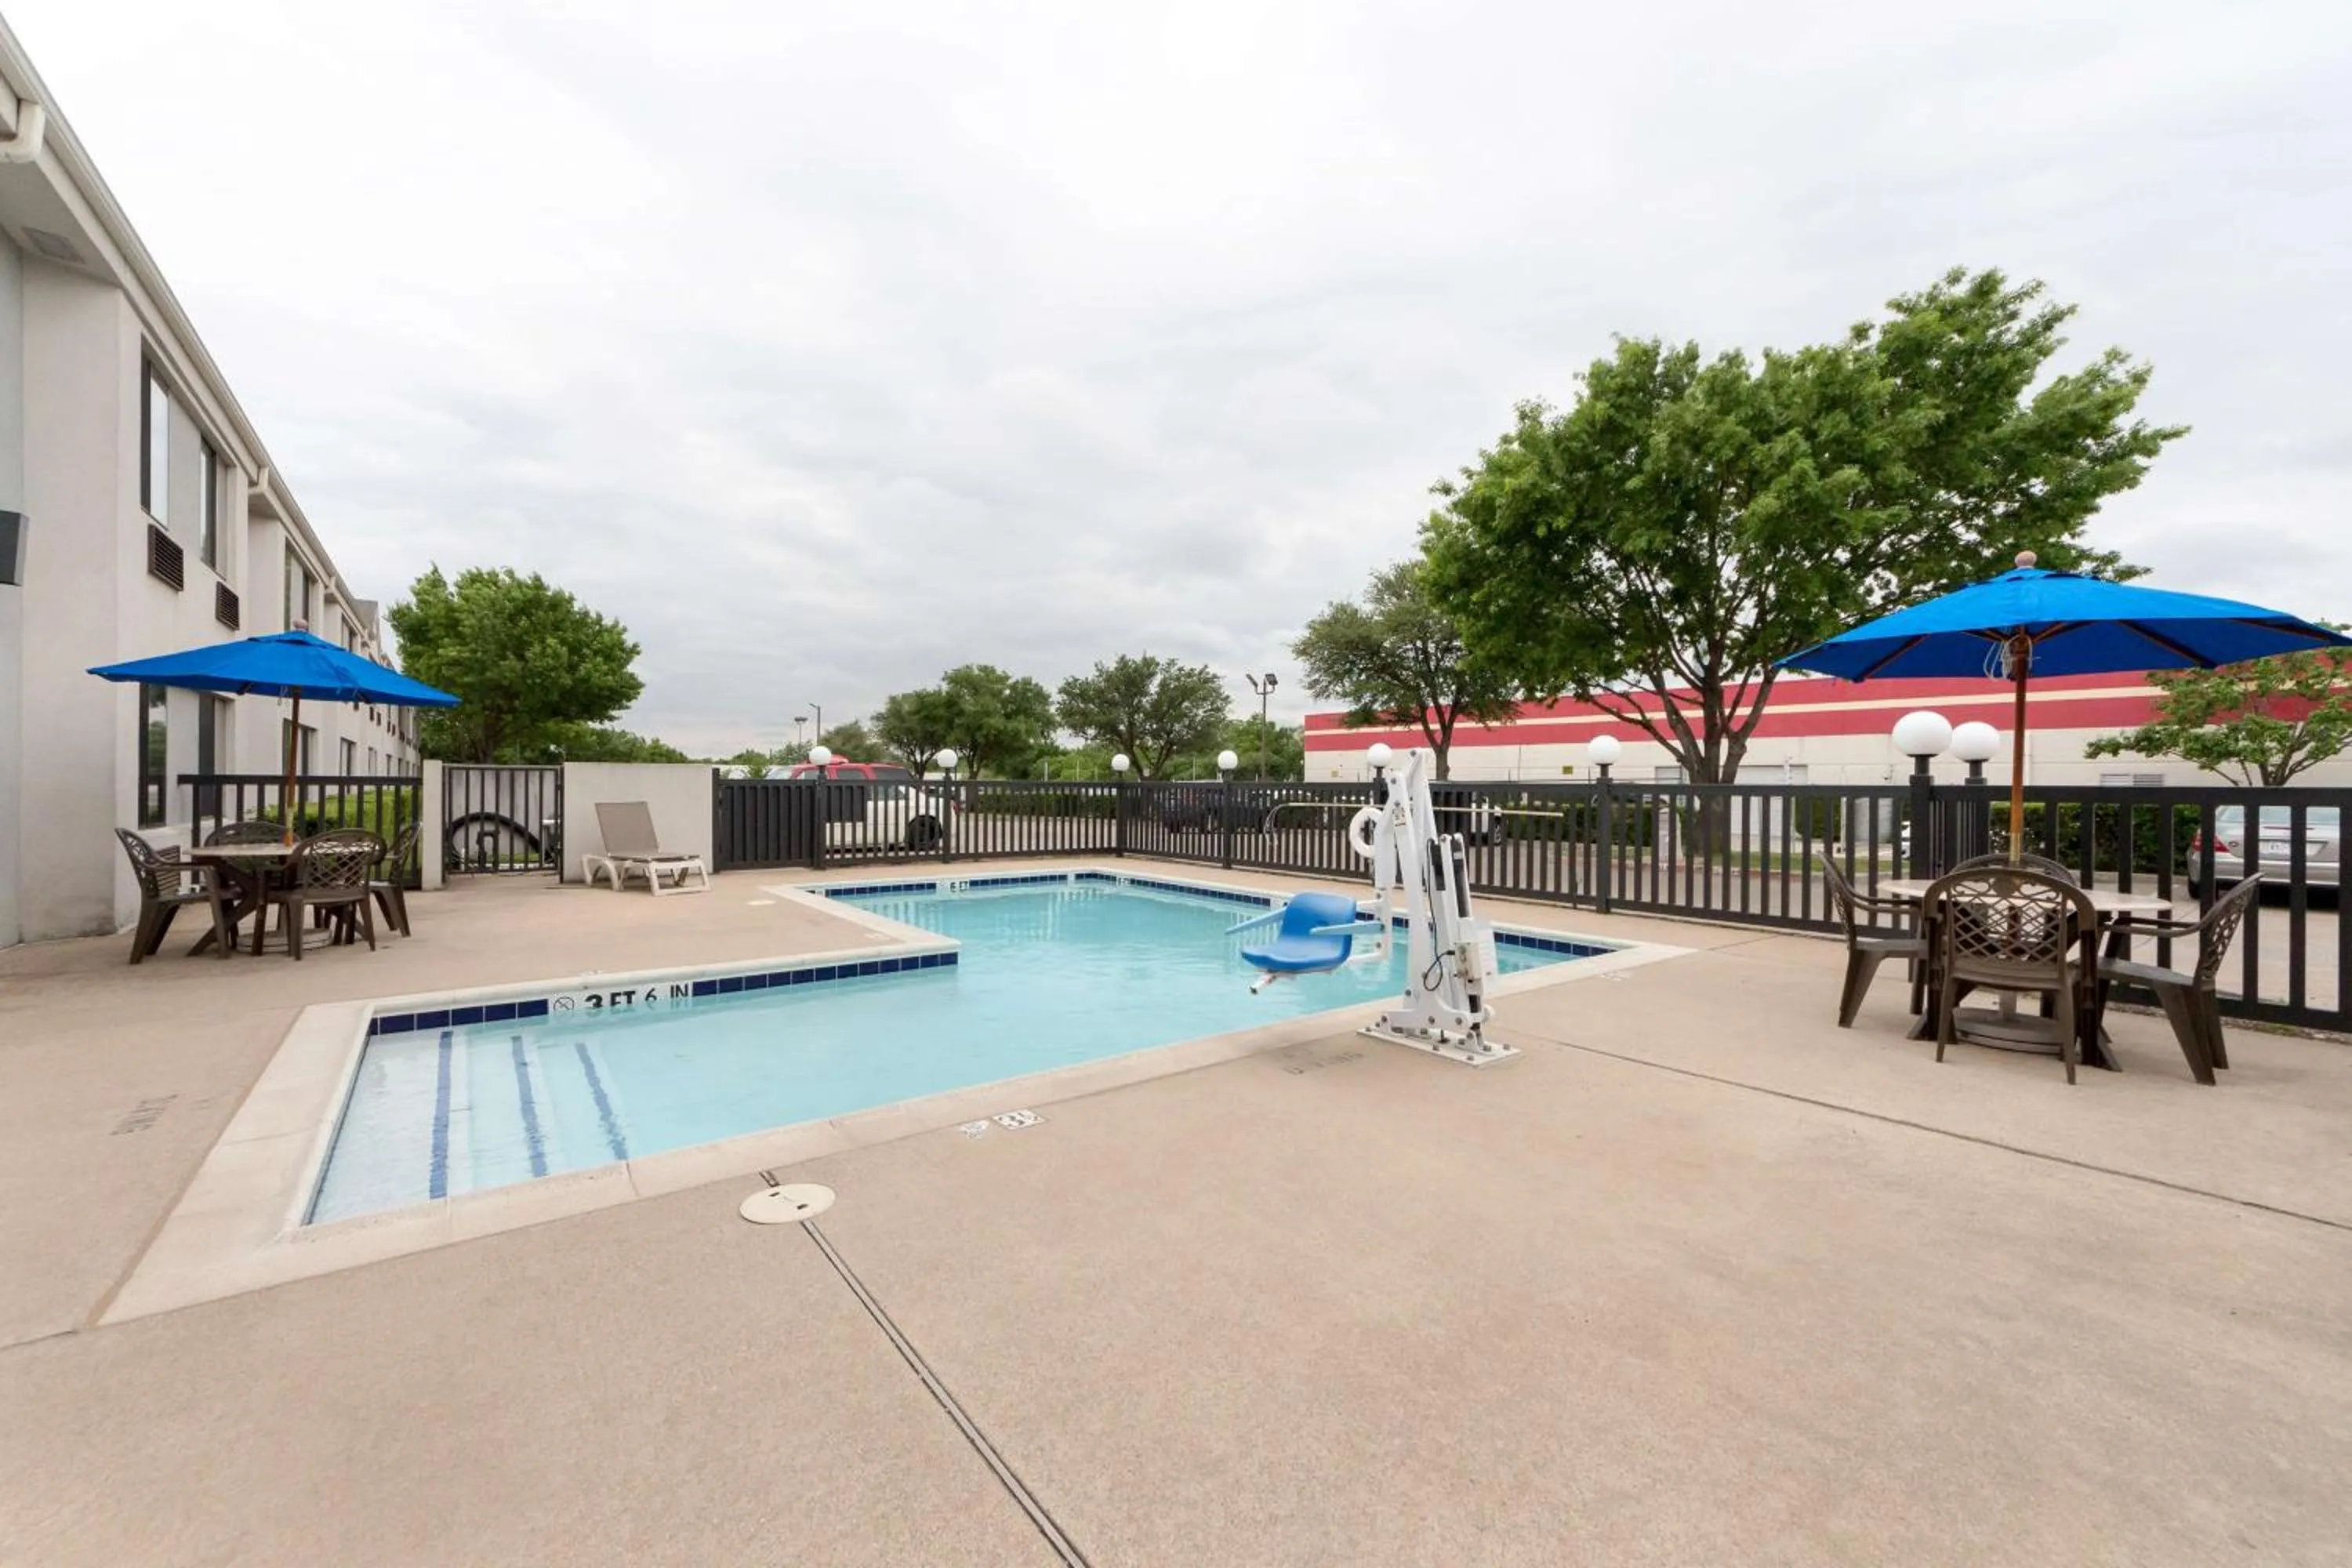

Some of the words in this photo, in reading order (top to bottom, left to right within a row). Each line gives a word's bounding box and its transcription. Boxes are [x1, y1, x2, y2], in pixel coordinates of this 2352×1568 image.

[585, 993, 603, 1008] 3
[610, 990, 636, 1007] FT
[644, 988, 657, 1001] 6
[670, 983, 688, 998] IN
